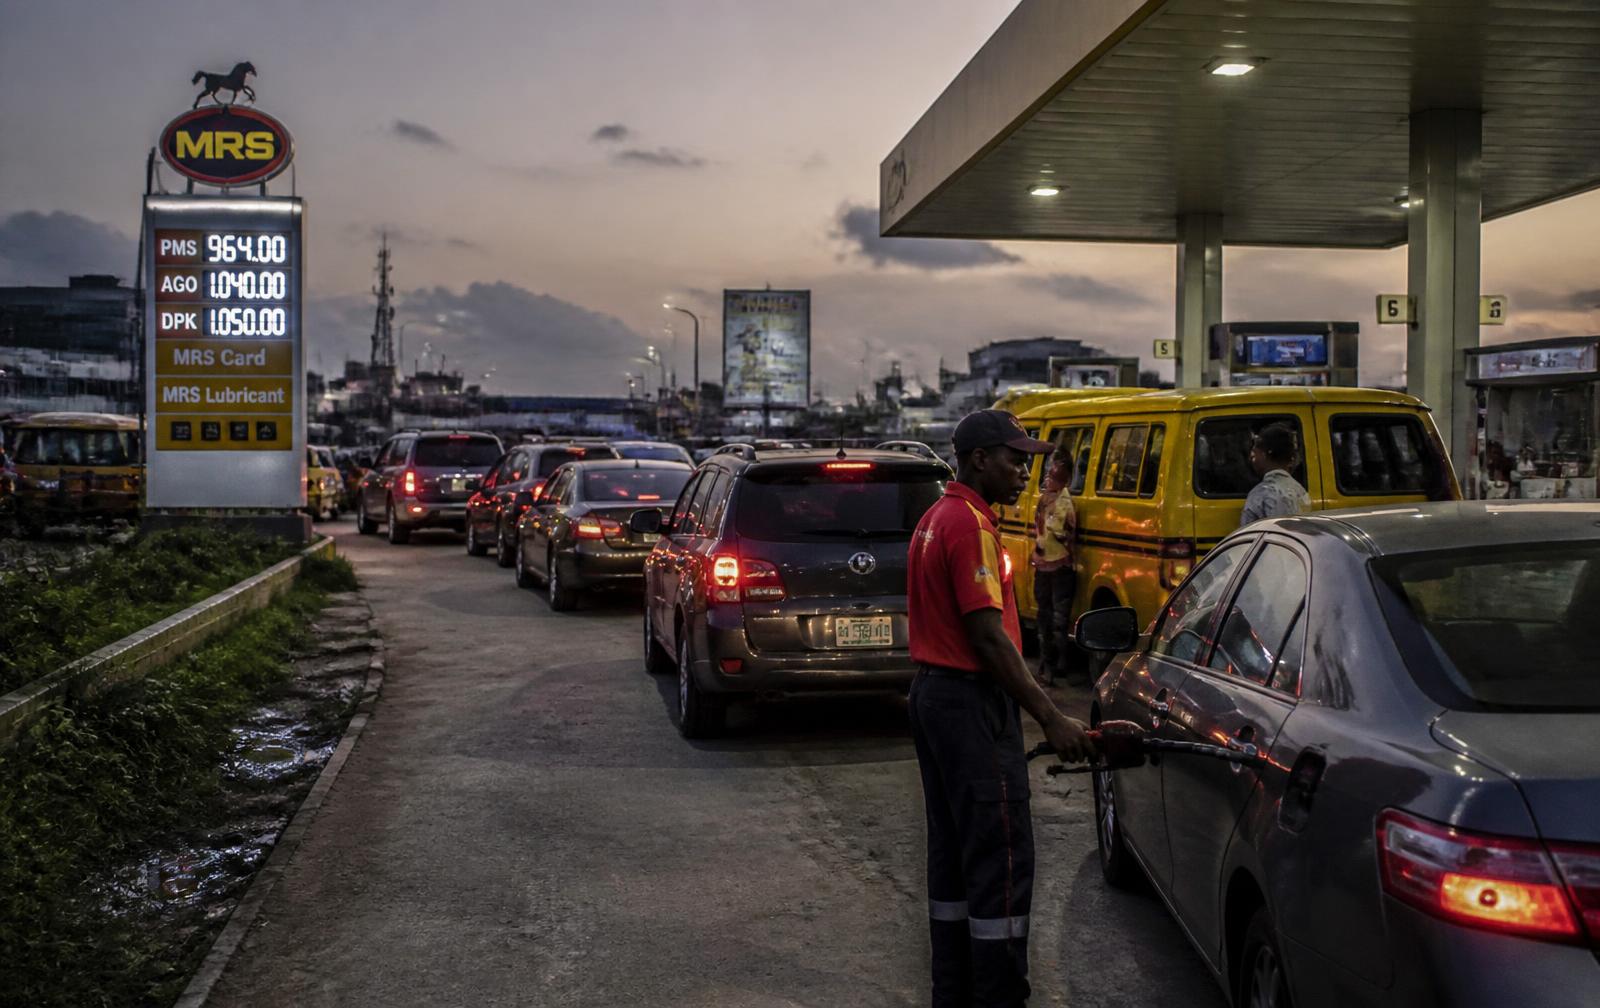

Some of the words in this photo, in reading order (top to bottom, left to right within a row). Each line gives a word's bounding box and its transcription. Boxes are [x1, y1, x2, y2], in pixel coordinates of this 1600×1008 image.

[175, 131, 275, 160] MRS
[160, 239, 197, 256] PMS
[208, 234, 286, 263] 964.00
[161, 275, 198, 293] AGO
[1387, 299, 1399, 318] 6
[161, 312, 198, 330] DPK
[173, 348, 215, 366] MRS
[220, 347, 266, 367] Card
[162, 386, 200, 404] MRS
[205, 386, 285, 404] Lubricant
